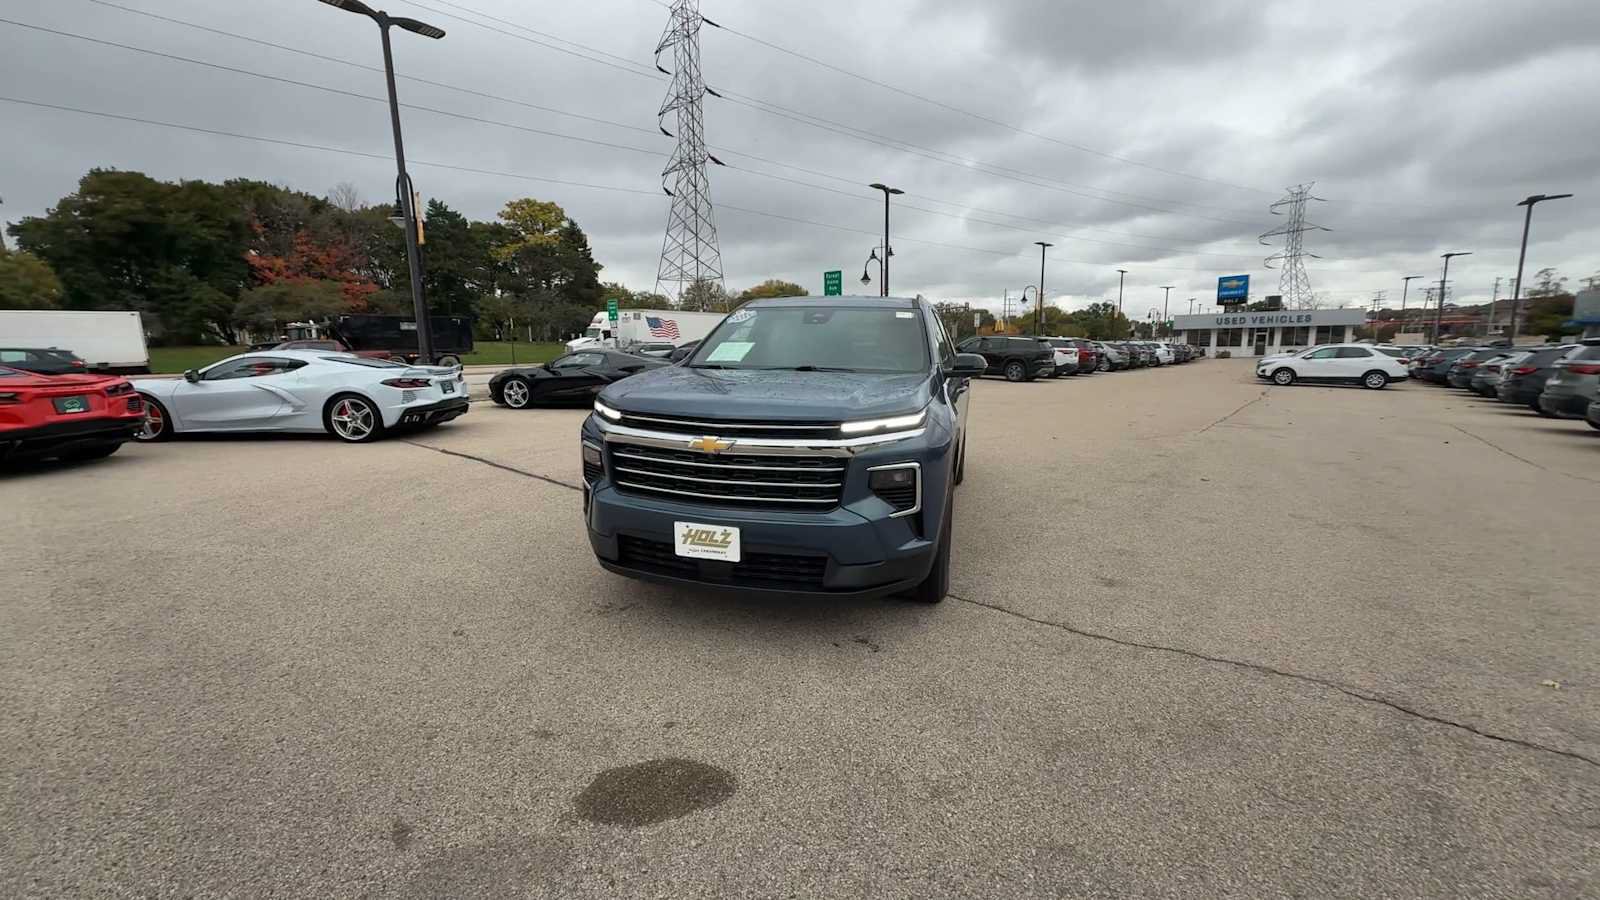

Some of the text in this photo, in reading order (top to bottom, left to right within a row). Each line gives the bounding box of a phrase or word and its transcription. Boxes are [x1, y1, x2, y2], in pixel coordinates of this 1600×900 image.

[1216, 314, 1312, 326] USED VEHICLES
[681, 528, 732, 545] HOLZ
